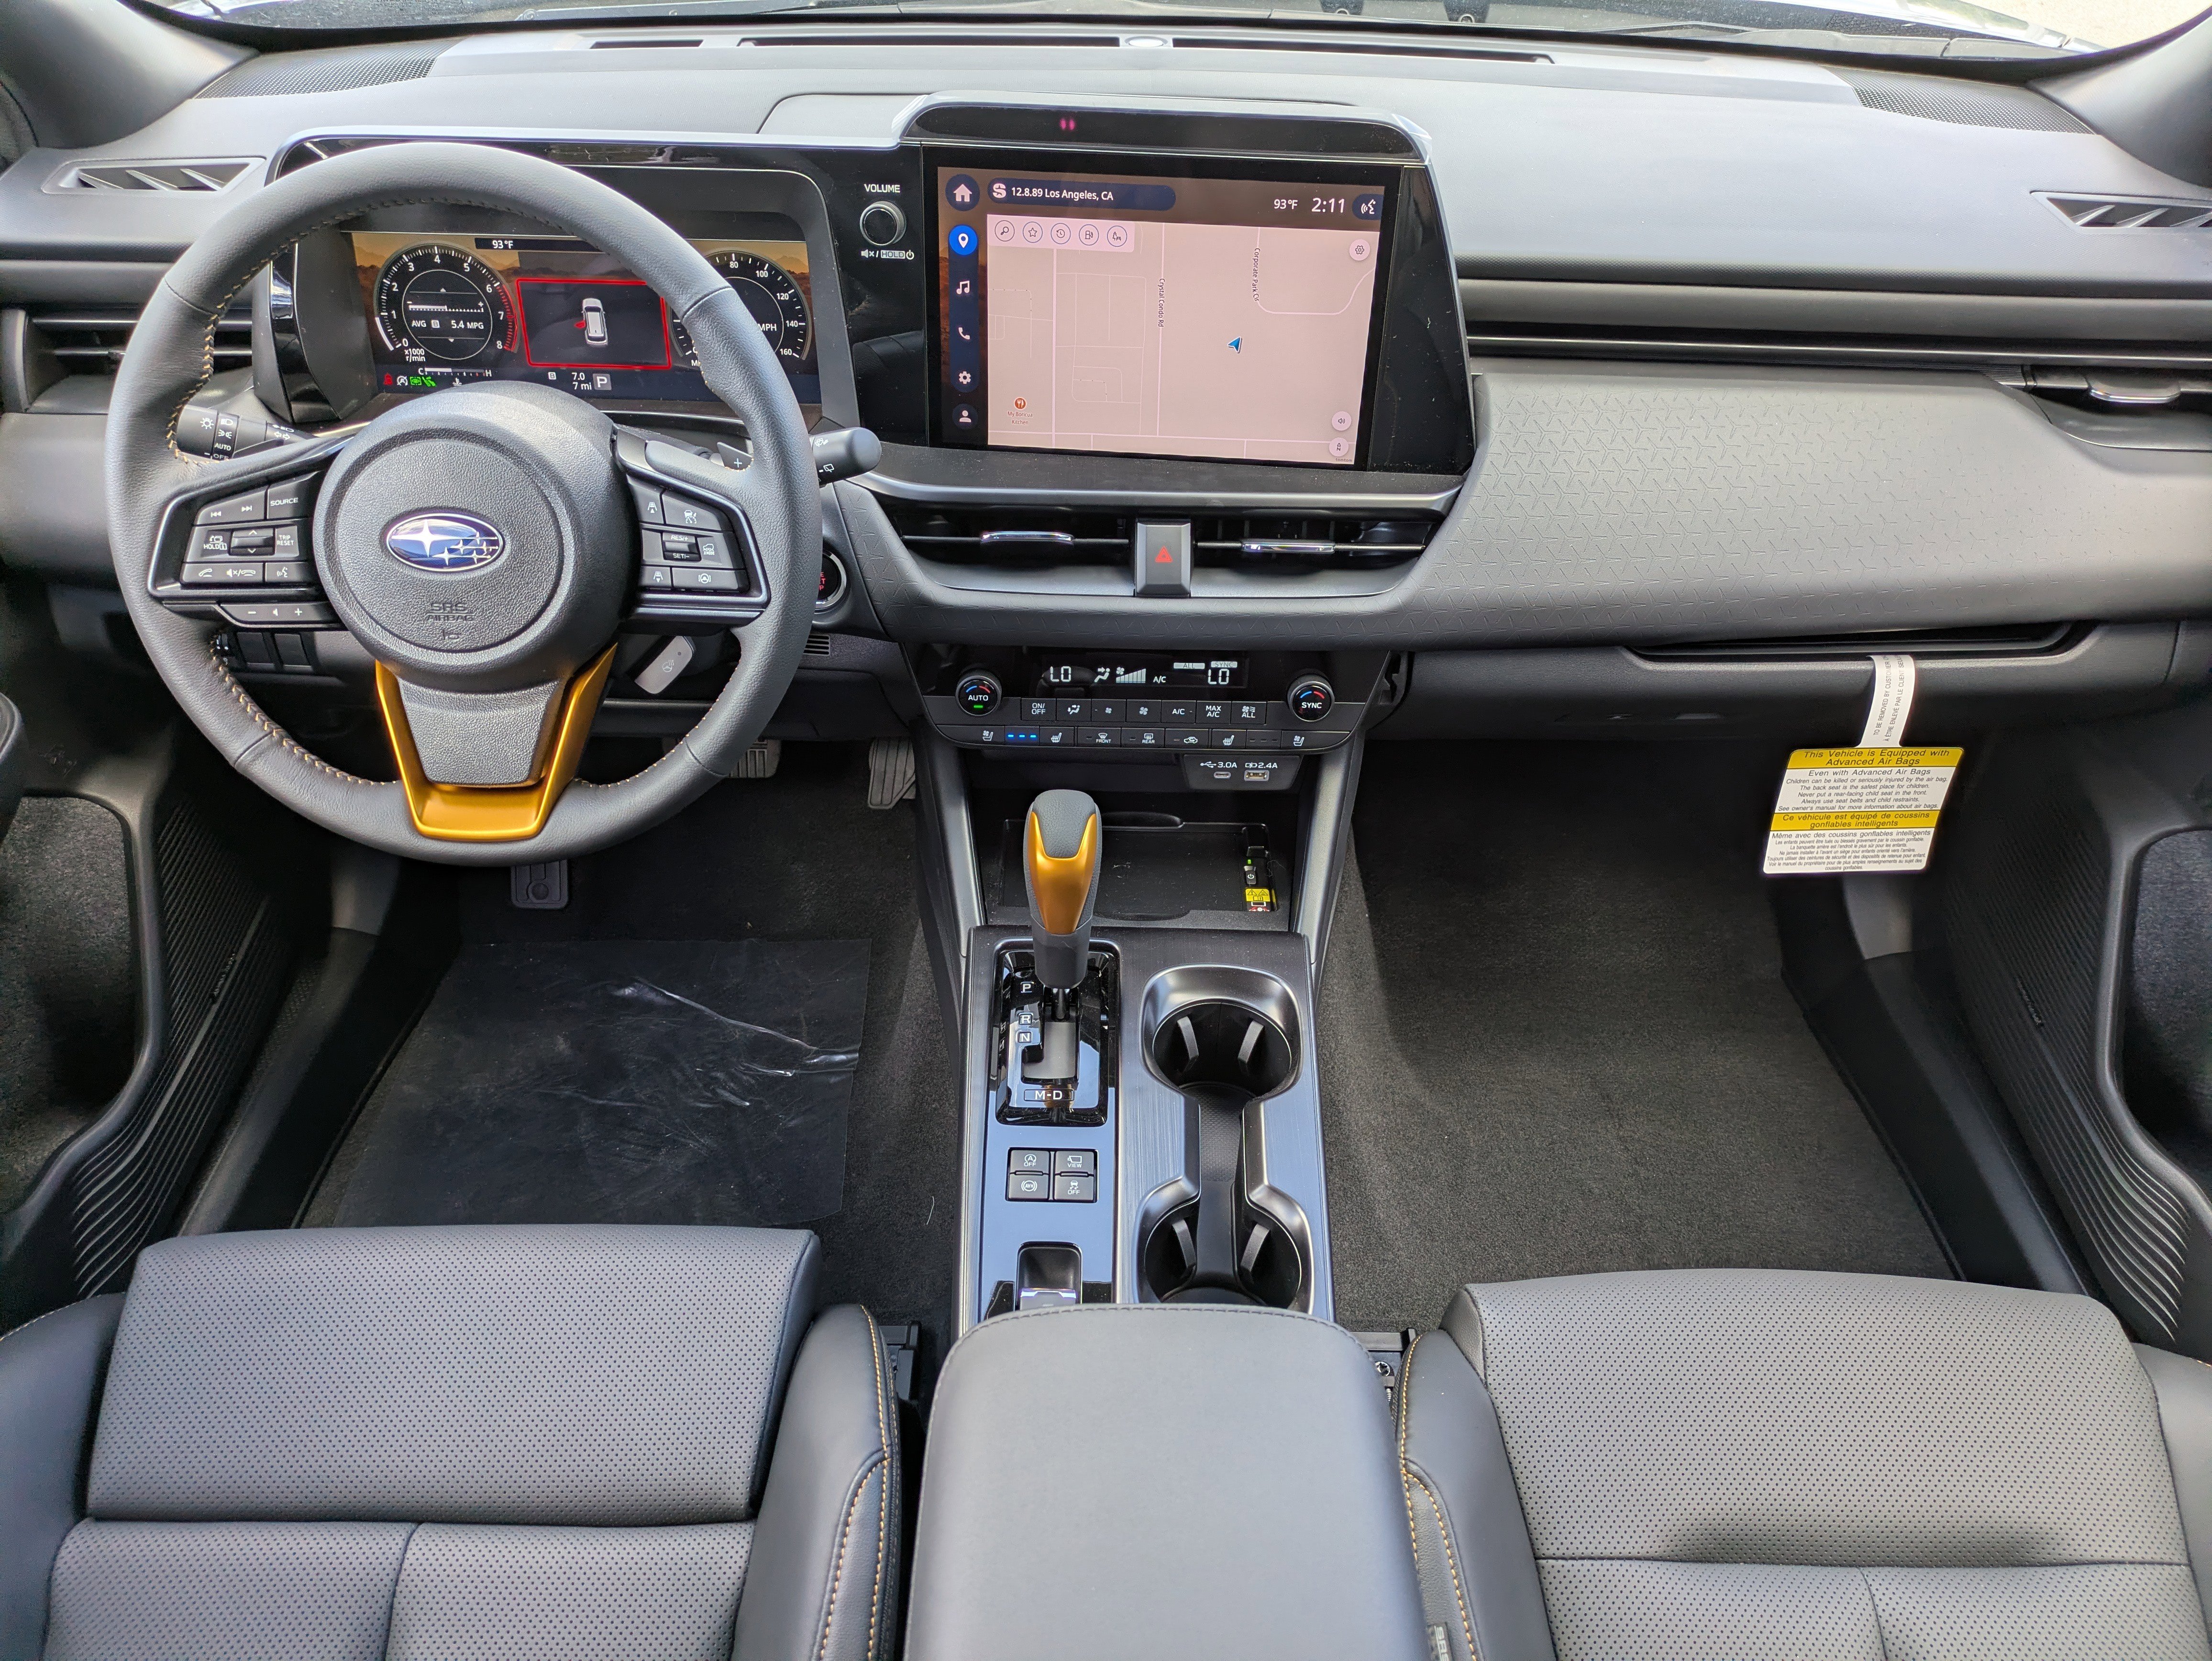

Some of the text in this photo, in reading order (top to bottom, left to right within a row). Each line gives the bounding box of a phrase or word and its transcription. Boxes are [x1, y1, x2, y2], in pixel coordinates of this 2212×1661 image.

[864, 184, 900, 192] VOLUME
[1011, 188, 1114, 201] 12.8.89 Los Angeles, CA
[1274, 199, 1298, 210] 93°F
[1312, 198, 1344, 213] 2:11
[492, 240, 513, 249] 93°F
[434, 255, 440, 264] 4
[1252, 248, 1261, 278] Corporate
[408, 263, 414, 271] 3
[464, 263, 470, 272] 5
[392, 282, 398, 291] 2
[486, 284, 492, 293] 6
[392, 310, 396, 319] 1
[498, 311, 504, 320] 7
[497, 341, 502, 349] 8
[571, 372, 585, 380] 7.0
[581, 382, 592, 390] mi
[597, 376, 607, 388] P
[271, 498, 299, 506] SOURCE
[431, 603, 468, 613] SRS
[1050, 666, 1071, 682] LO
[1208, 669, 1229, 685] LO
[1878, 699, 1888, 720] REMOVED
[1885, 726, 1893, 737] ÊTRE
[1890, 708, 1899, 724] ENLEVÉ
[1896, 758, 1920, 766] Bags
[1810, 821, 1851, 829] gonflables
